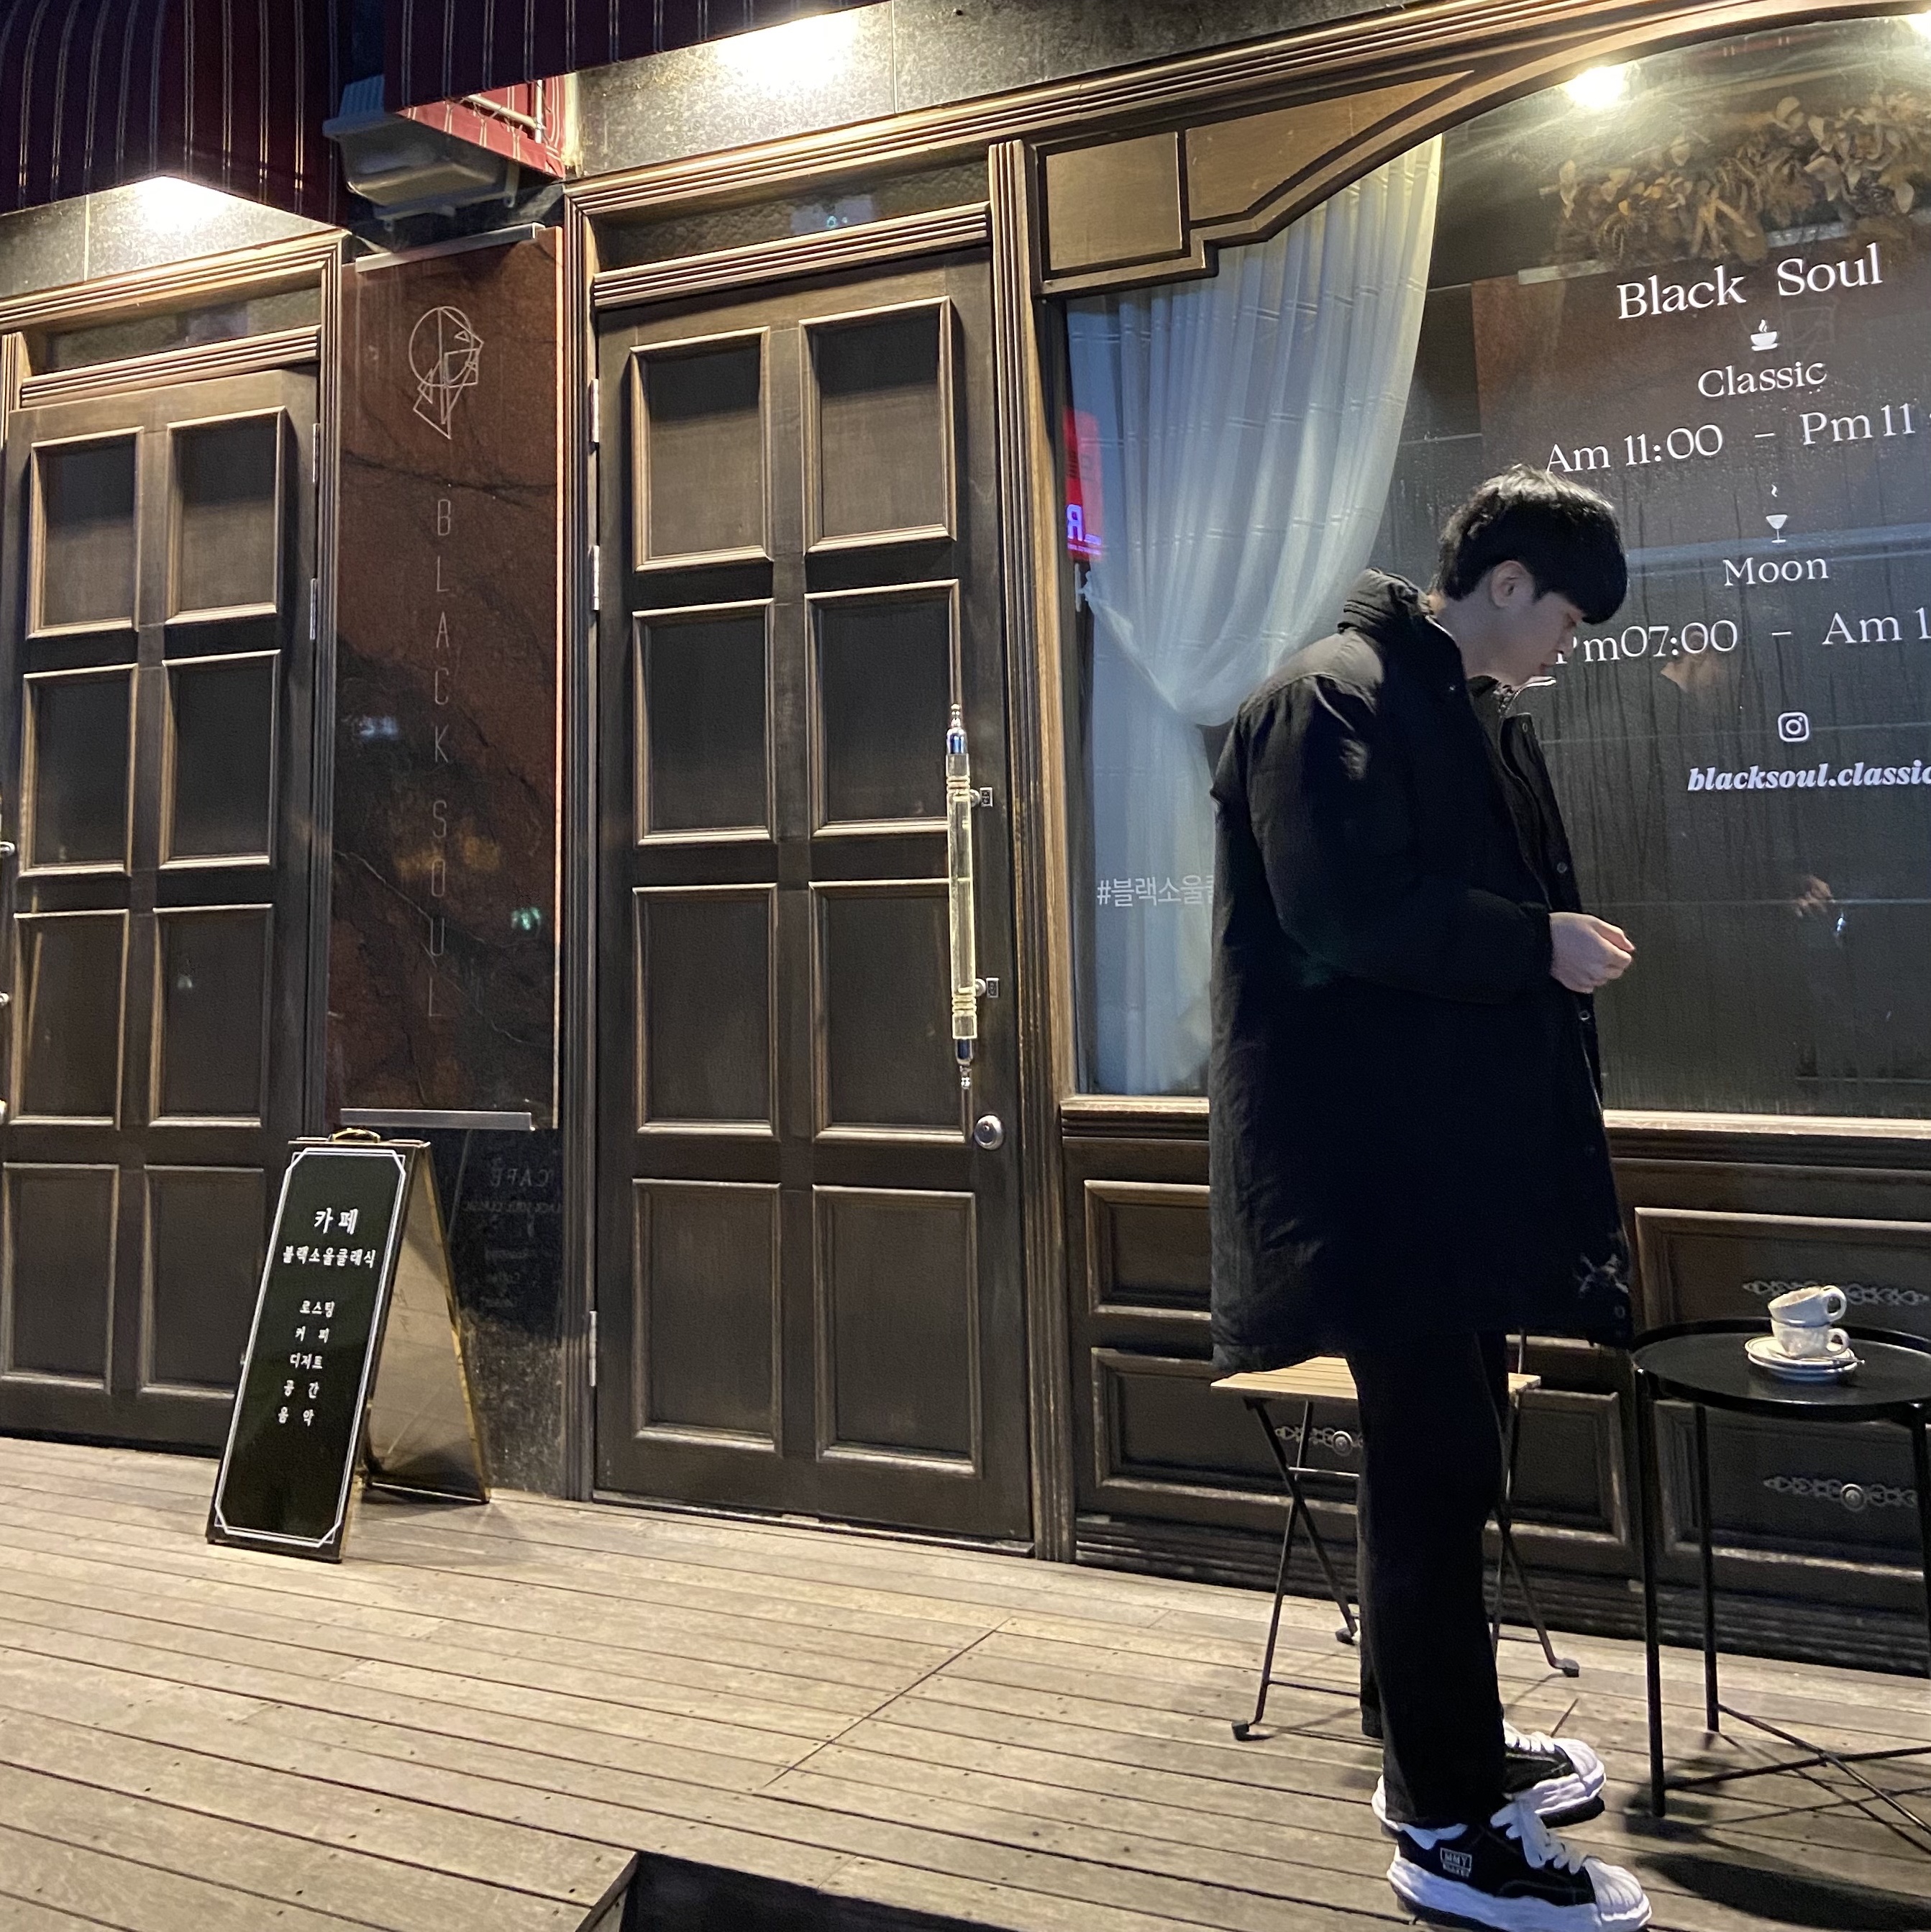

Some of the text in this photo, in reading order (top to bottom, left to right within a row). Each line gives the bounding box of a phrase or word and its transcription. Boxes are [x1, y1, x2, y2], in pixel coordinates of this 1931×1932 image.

[1617, 242, 1884, 319] Black Soul
[1698, 360, 1828, 398] Classic
[1546, 443, 1611, 474] Am
[1623, 423, 1724, 467] 11:00
[1722, 556, 1829, 587] Moon
[1822, 611, 1903, 645] Am
[299, 1300, 335, 1318] 로스팅
[289, 1352, 323, 1370] 디저트
